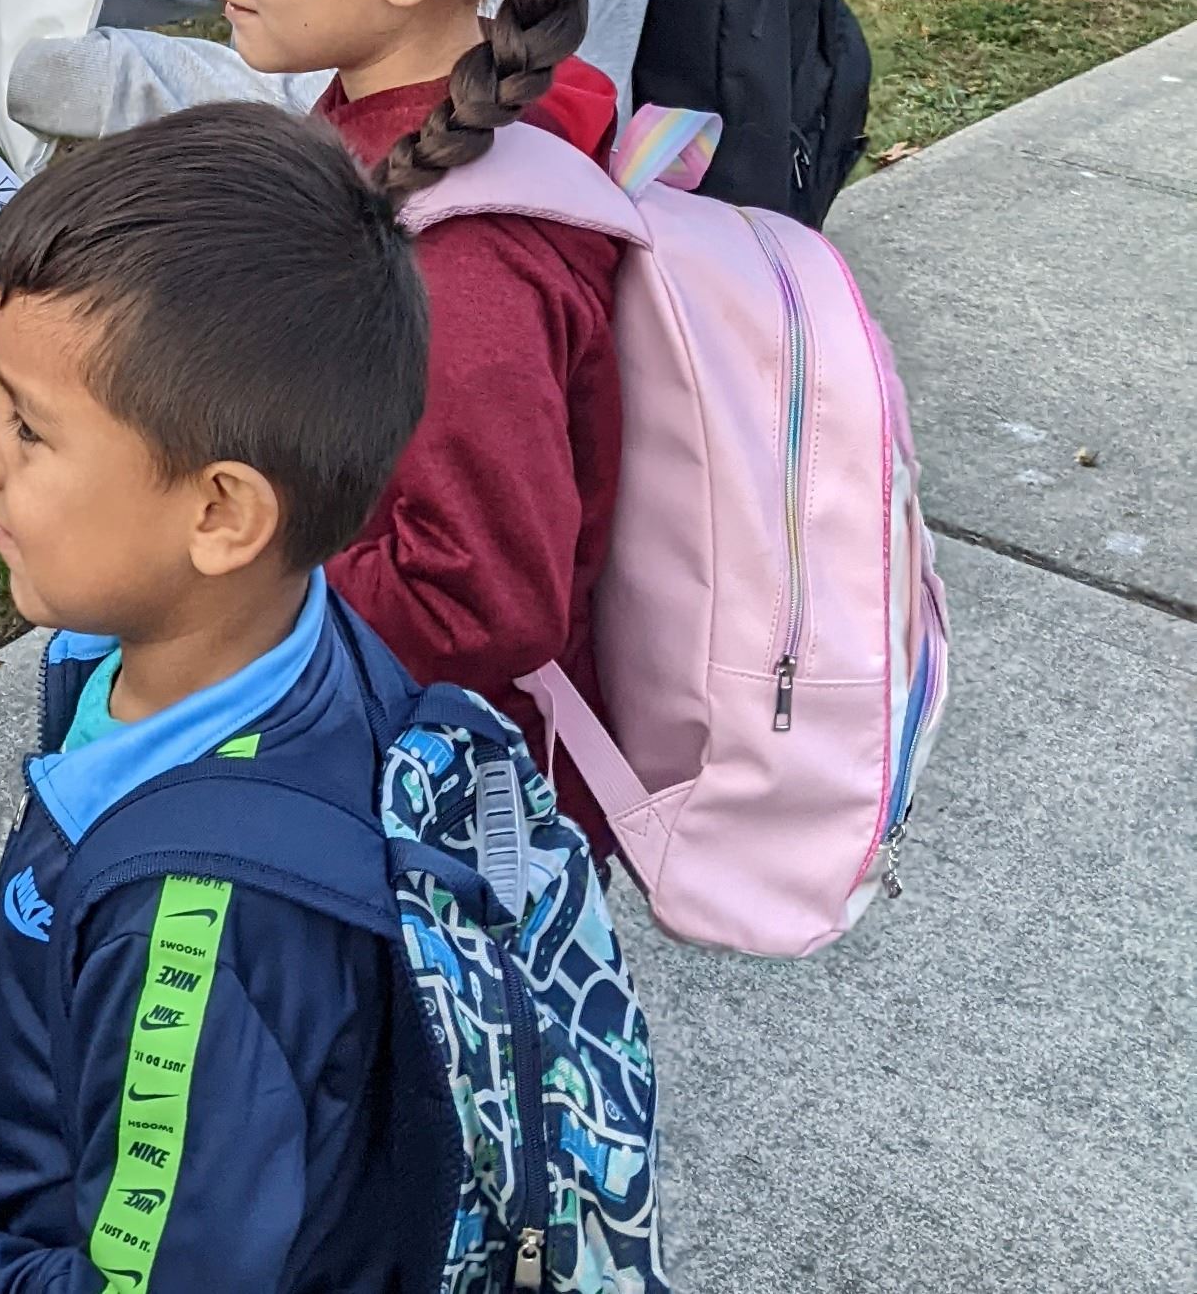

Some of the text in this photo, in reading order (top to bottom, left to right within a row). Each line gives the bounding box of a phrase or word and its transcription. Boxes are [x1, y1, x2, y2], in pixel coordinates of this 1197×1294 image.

[160, 939, 207, 958] SWOOSH
[154, 965, 202, 993] NIKE
[148, 1004, 185, 1025] NIKE
[145, 1054, 161, 1067] DO
[161, 1059, 186, 1073] JUST
[127, 1119, 174, 1134] SWOOSH
[127, 1141, 171, 1168] NIKE
[123, 1191, 158, 1215] NIKE
[99, 1222, 124, 1240] JUST
[122, 1232, 139, 1246] DO
